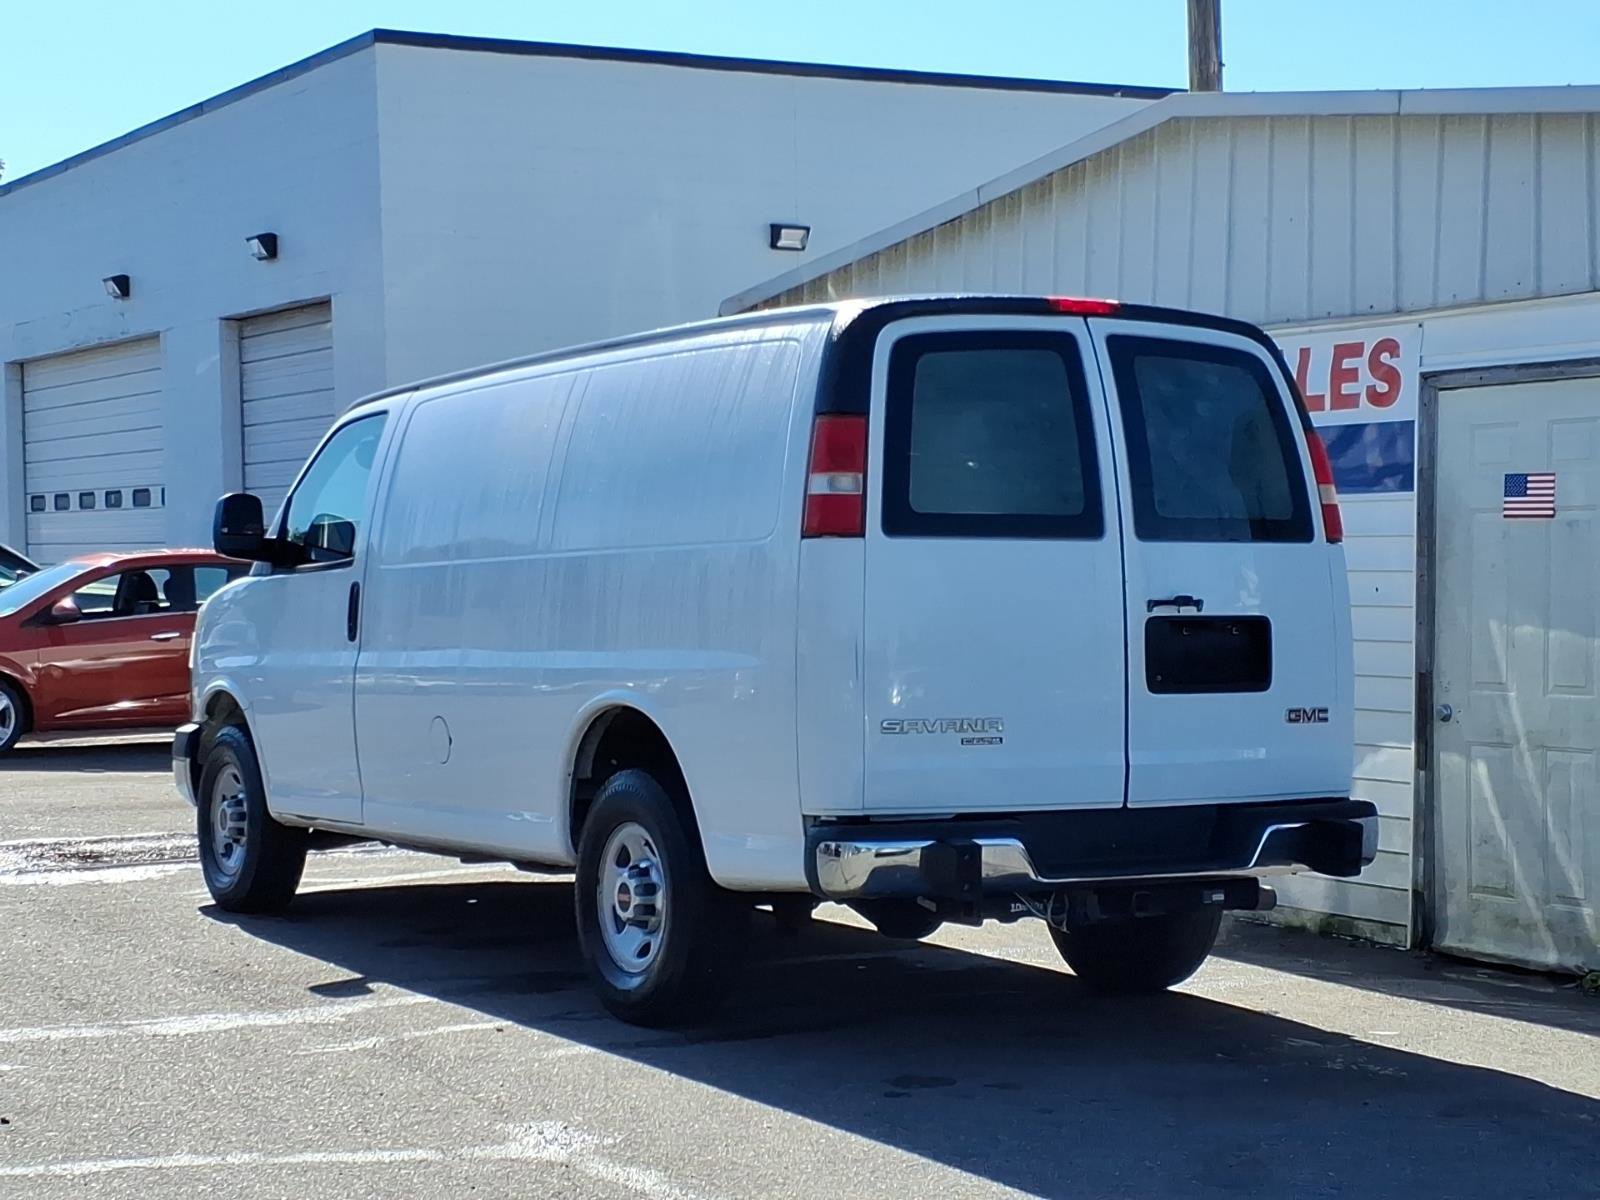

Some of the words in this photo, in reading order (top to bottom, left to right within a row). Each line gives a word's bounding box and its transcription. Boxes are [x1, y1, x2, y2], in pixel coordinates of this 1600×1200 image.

[1293, 337, 1402, 412] LES
[1286, 707, 1329, 723] GMC
[880, 718, 1004, 735] SAVANA
